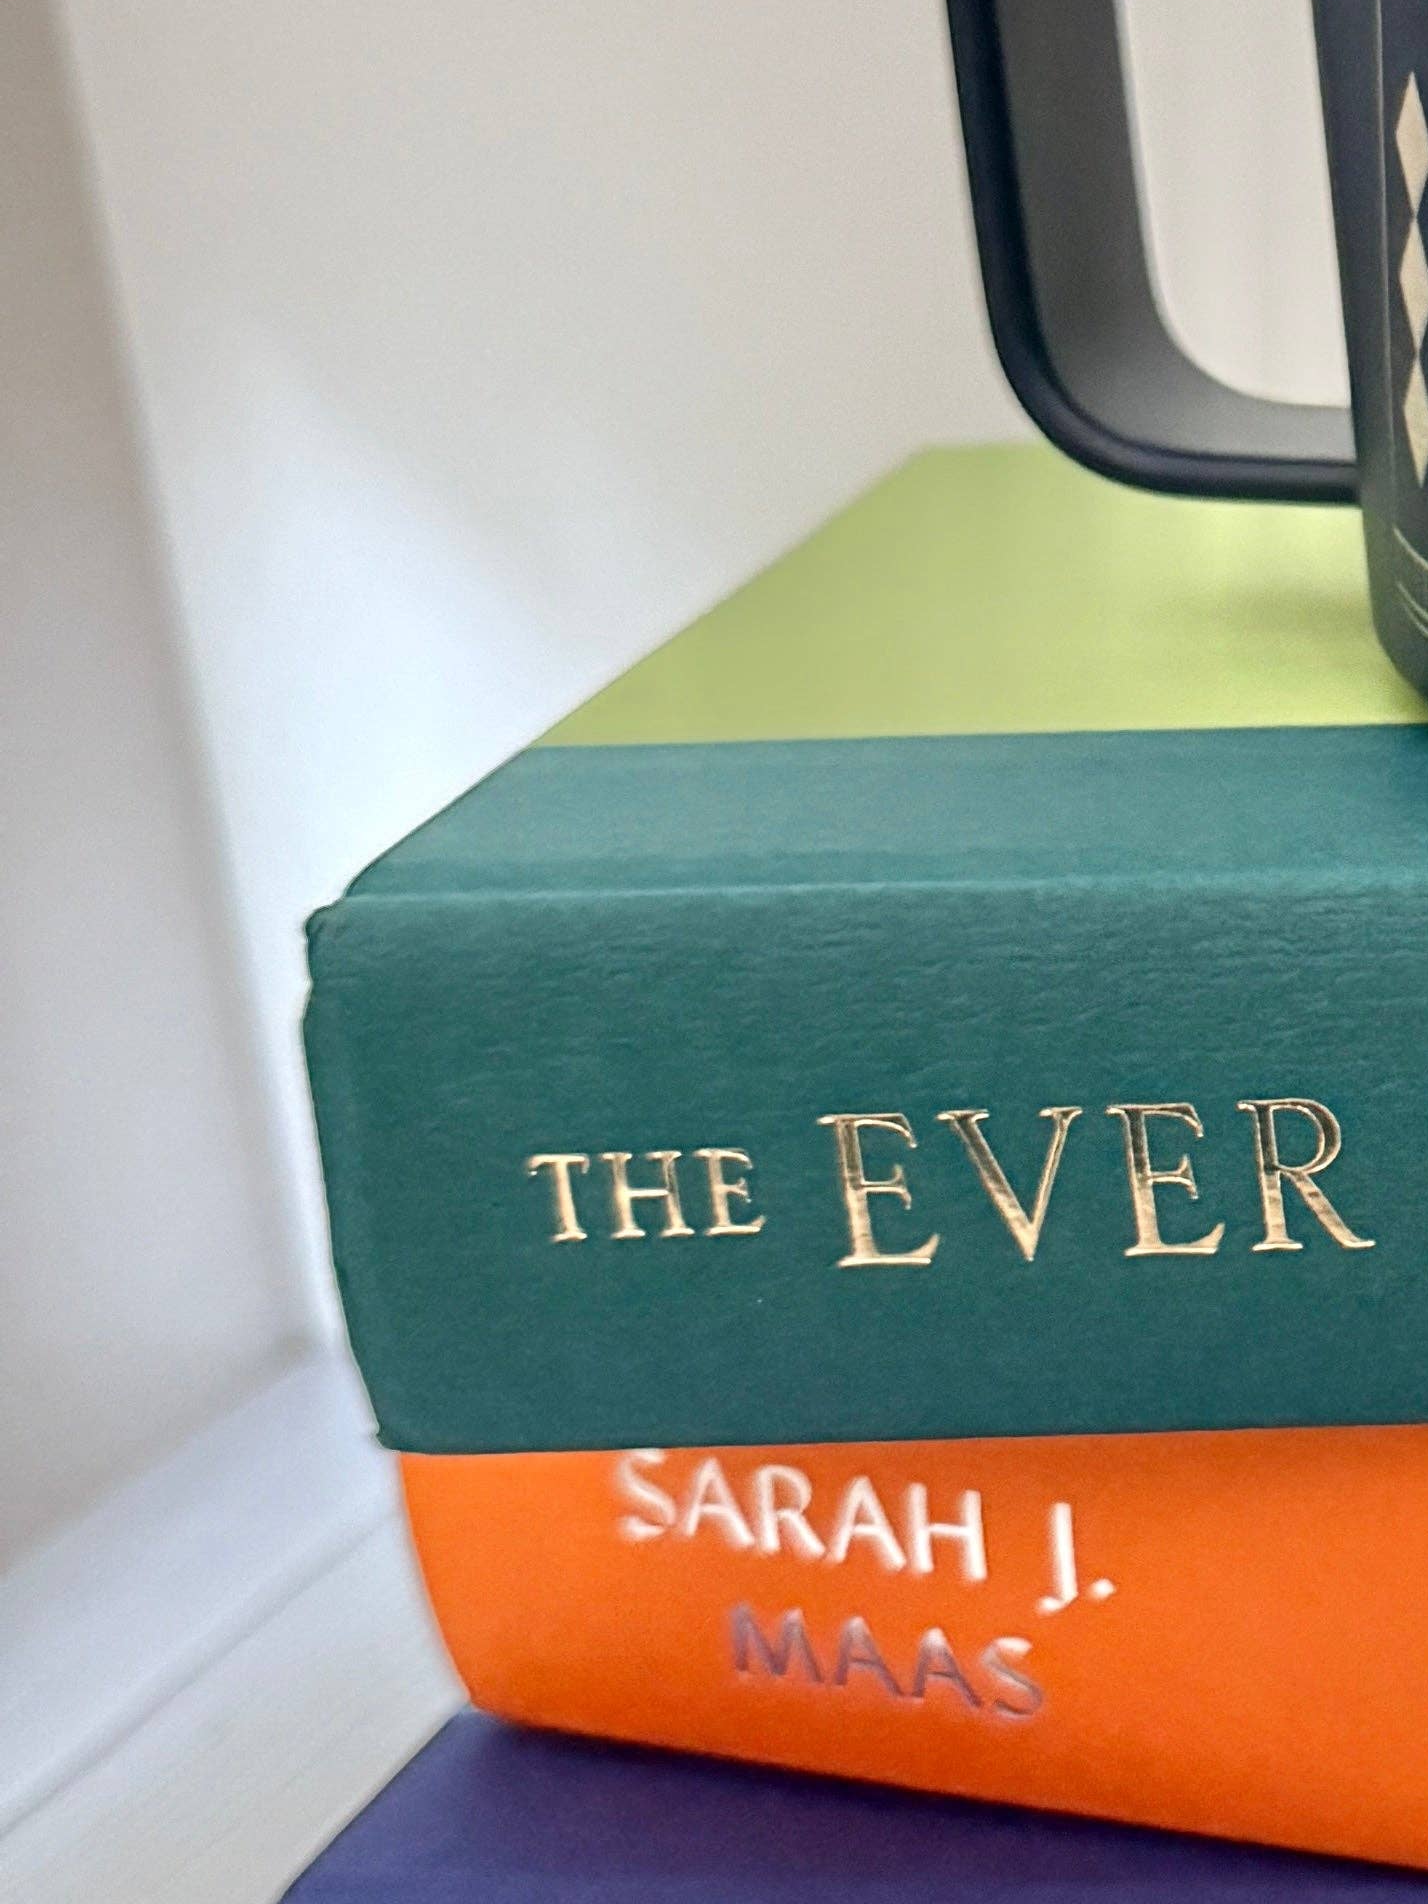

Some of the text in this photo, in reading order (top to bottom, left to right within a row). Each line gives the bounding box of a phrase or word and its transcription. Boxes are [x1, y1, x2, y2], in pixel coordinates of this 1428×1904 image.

[527, 1147, 767, 1244] THE
[816, 1098, 1376, 1269] EVER
[617, 1448, 1116, 1616] SARAH J.
[731, 1602, 1044, 1718] MAAS
